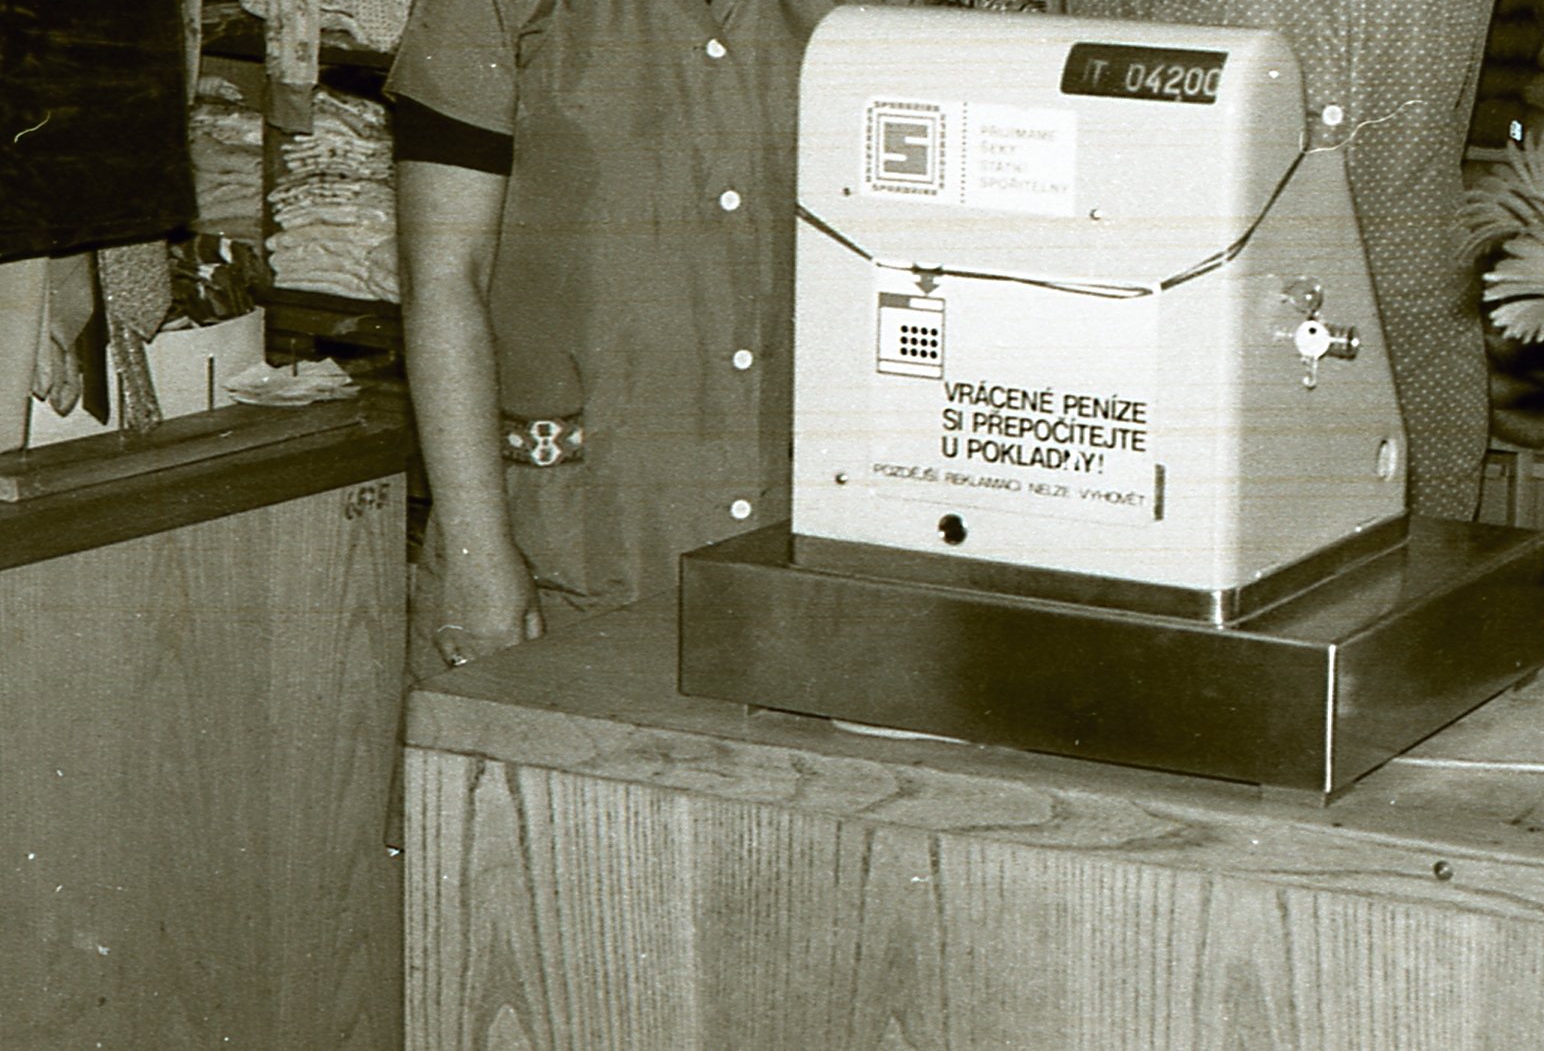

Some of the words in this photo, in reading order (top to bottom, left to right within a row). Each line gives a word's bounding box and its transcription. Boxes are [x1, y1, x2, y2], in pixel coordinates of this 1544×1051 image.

[944, 380, 1055, 414] VRÁCENÉ
[1063, 394, 1147, 424] PENÍZE
[942, 408, 963, 431] SI
[973, 410, 1147, 452] PŘEPOČÍTEJTE
[941, 436, 958, 458] U
[1028, 482, 1069, 498] NELZE
